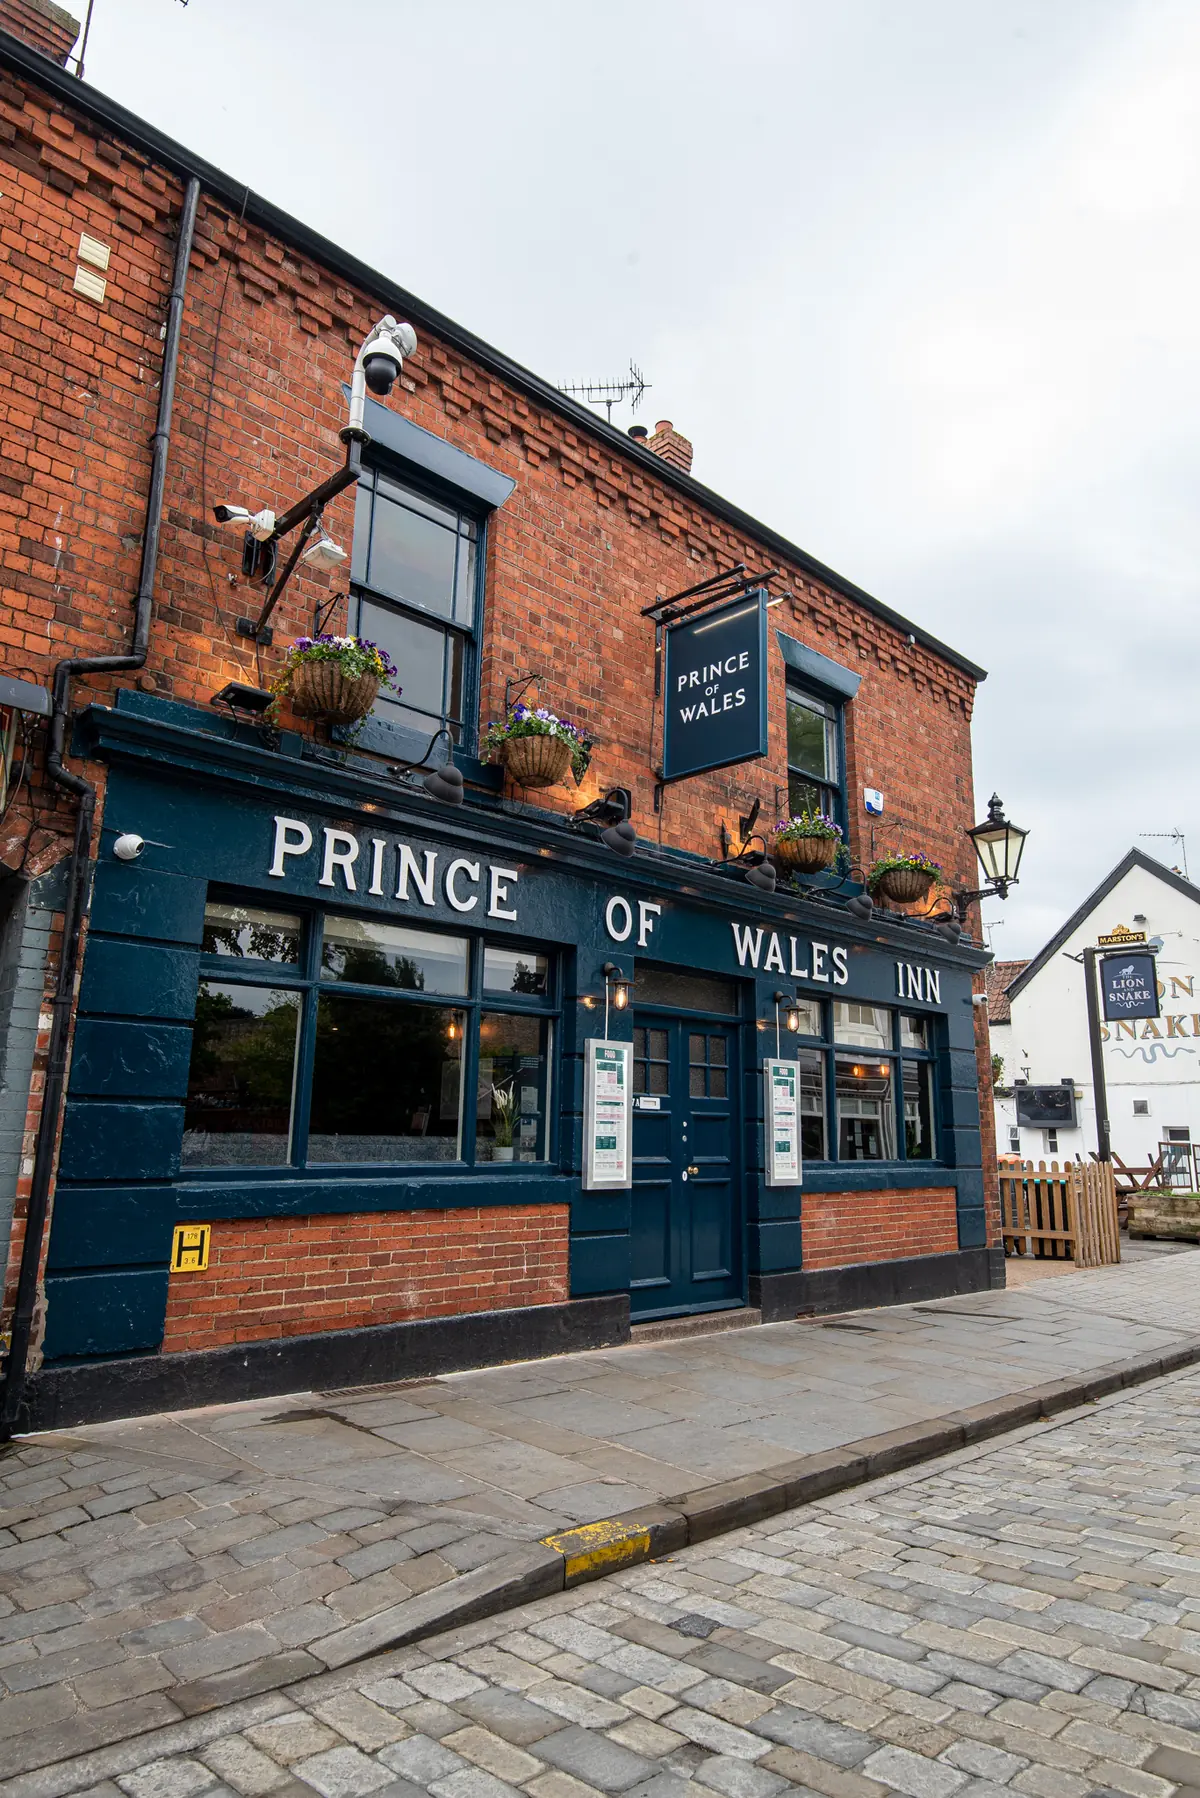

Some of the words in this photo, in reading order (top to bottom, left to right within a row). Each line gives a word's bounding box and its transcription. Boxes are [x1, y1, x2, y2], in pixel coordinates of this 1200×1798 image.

[677, 651, 750, 693] PRINCE
[704, 684, 720, 697] OF
[679, 688, 746, 724] WALES
[268, 815, 519, 922] PRINCE
[605, 895, 662, 948] OF
[731, 922, 849, 986] WALES
[895, 962, 943, 1005] INN
[1099, 933, 1144, 945] MARSTON'S
[1111, 978, 1145, 990] LION
[1108, 990, 1152, 1002] SNAKE
[604, 1049, 616, 1059] FOOD
[176, 1230, 206, 1268] H
